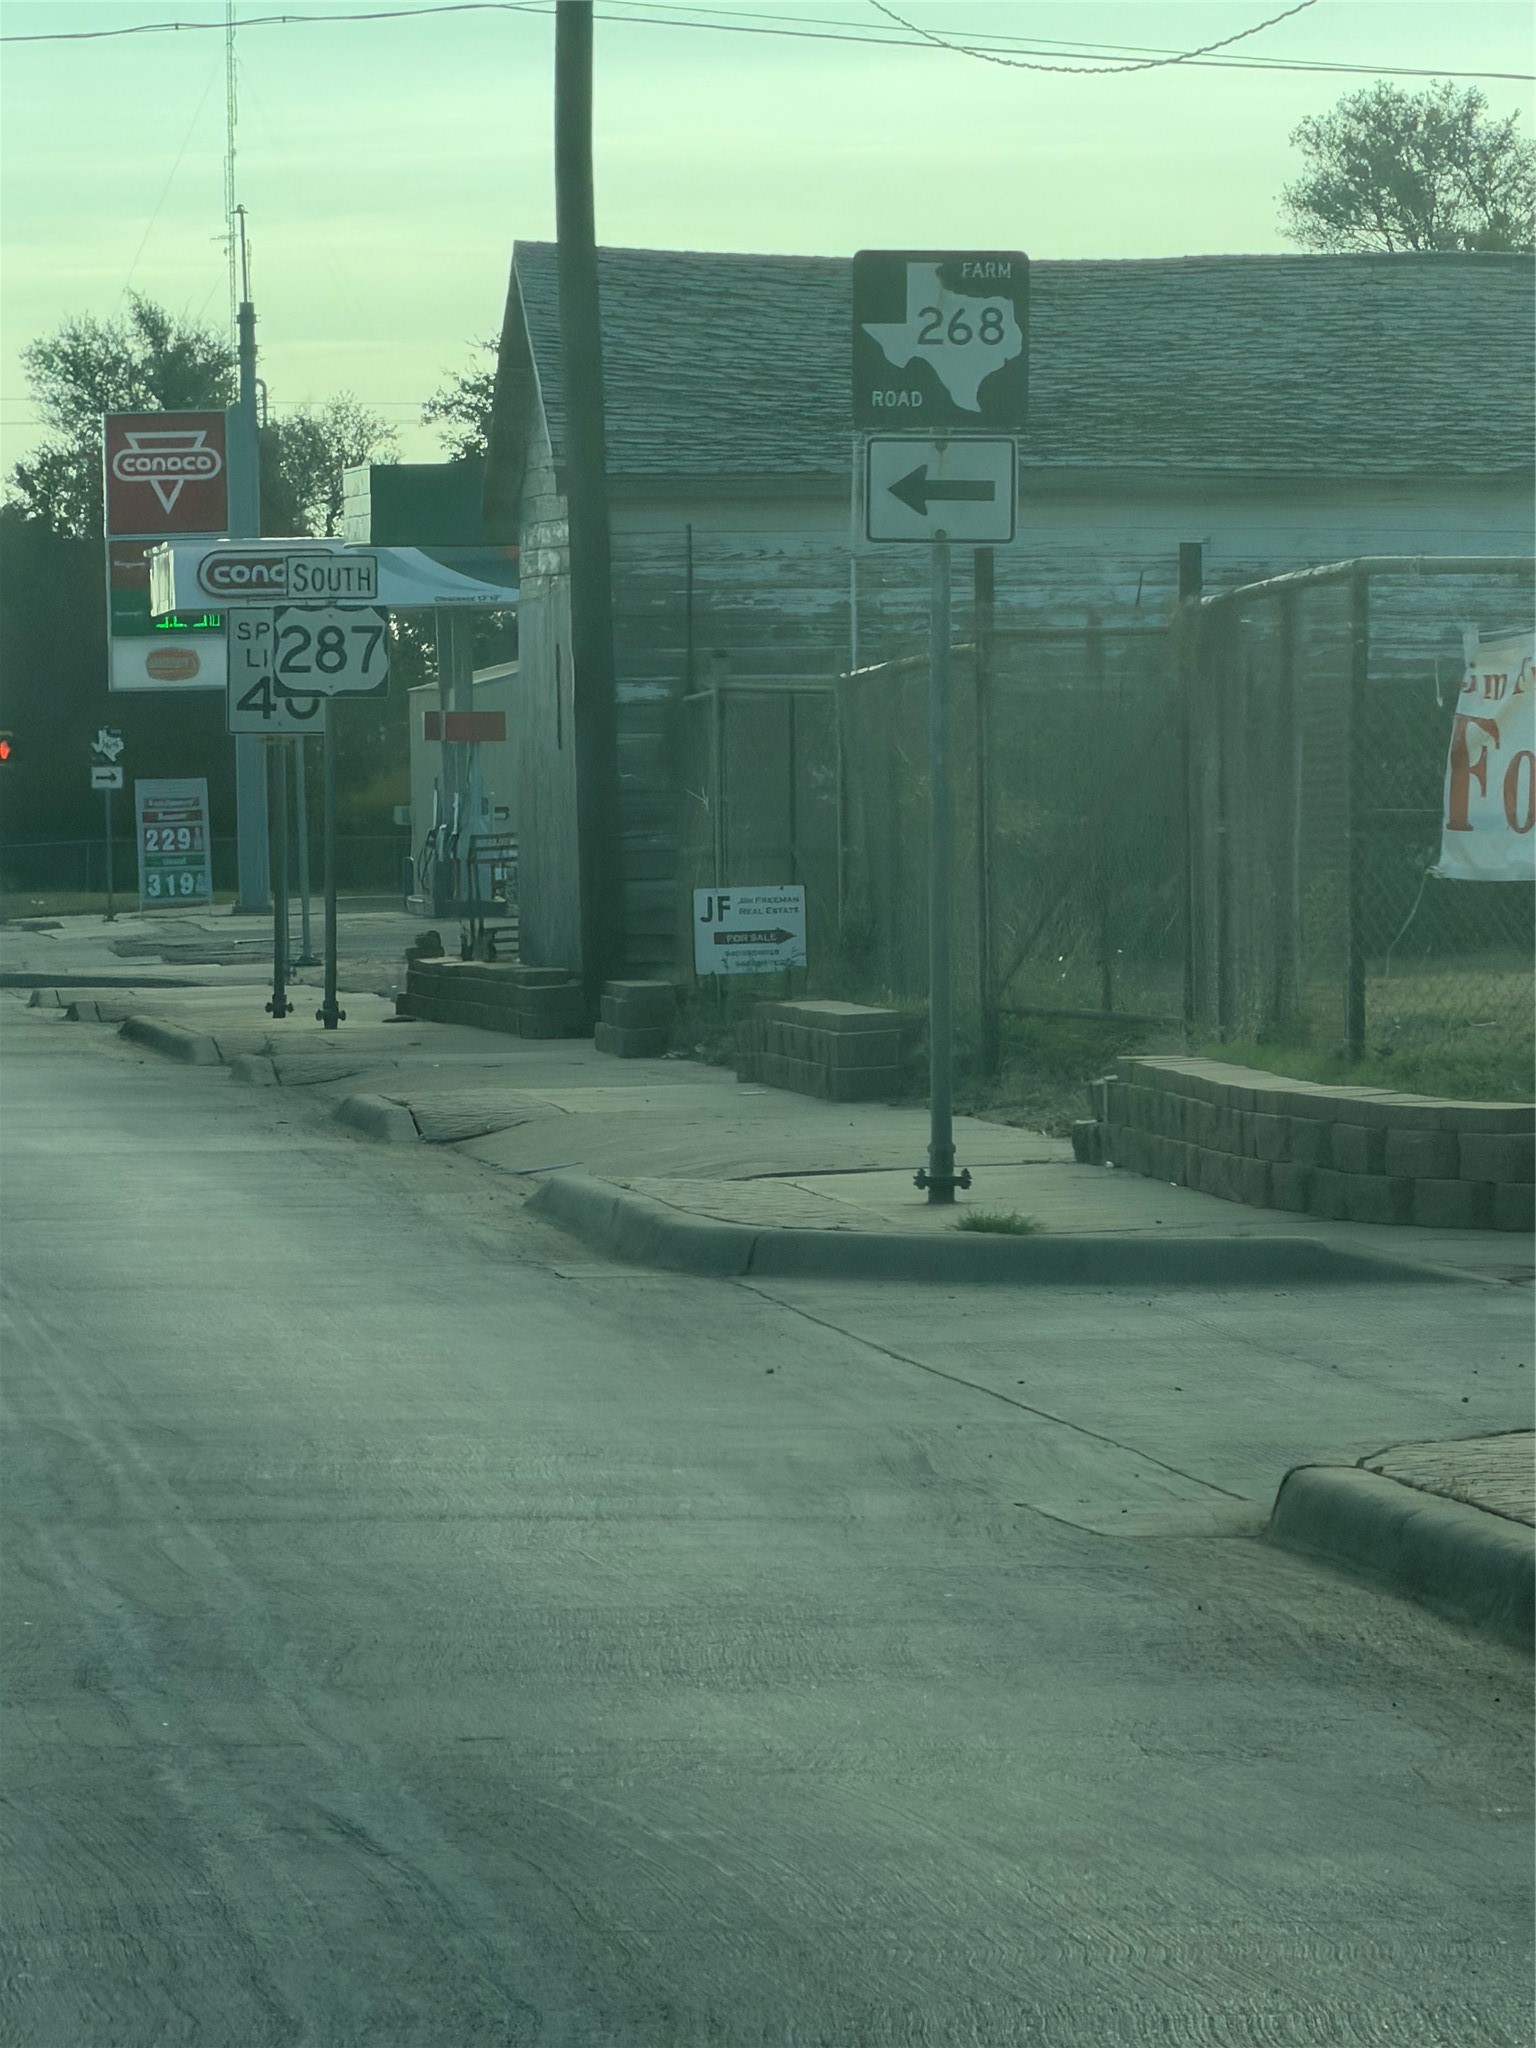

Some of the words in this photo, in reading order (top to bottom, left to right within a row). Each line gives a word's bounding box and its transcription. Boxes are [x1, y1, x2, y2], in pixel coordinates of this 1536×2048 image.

[961, 262, 1012, 279] FARM
[917, 306, 1005, 346] 268
[871, 390, 923, 408] ROAD
[121, 456, 212, 472] conoco
[293, 563, 371, 592] SOUTH
[236, 622, 270, 641] SP
[278, 624, 384, 674] 287
[700, 895, 731, 923] JF
[726, 934, 748, 943] FOR
